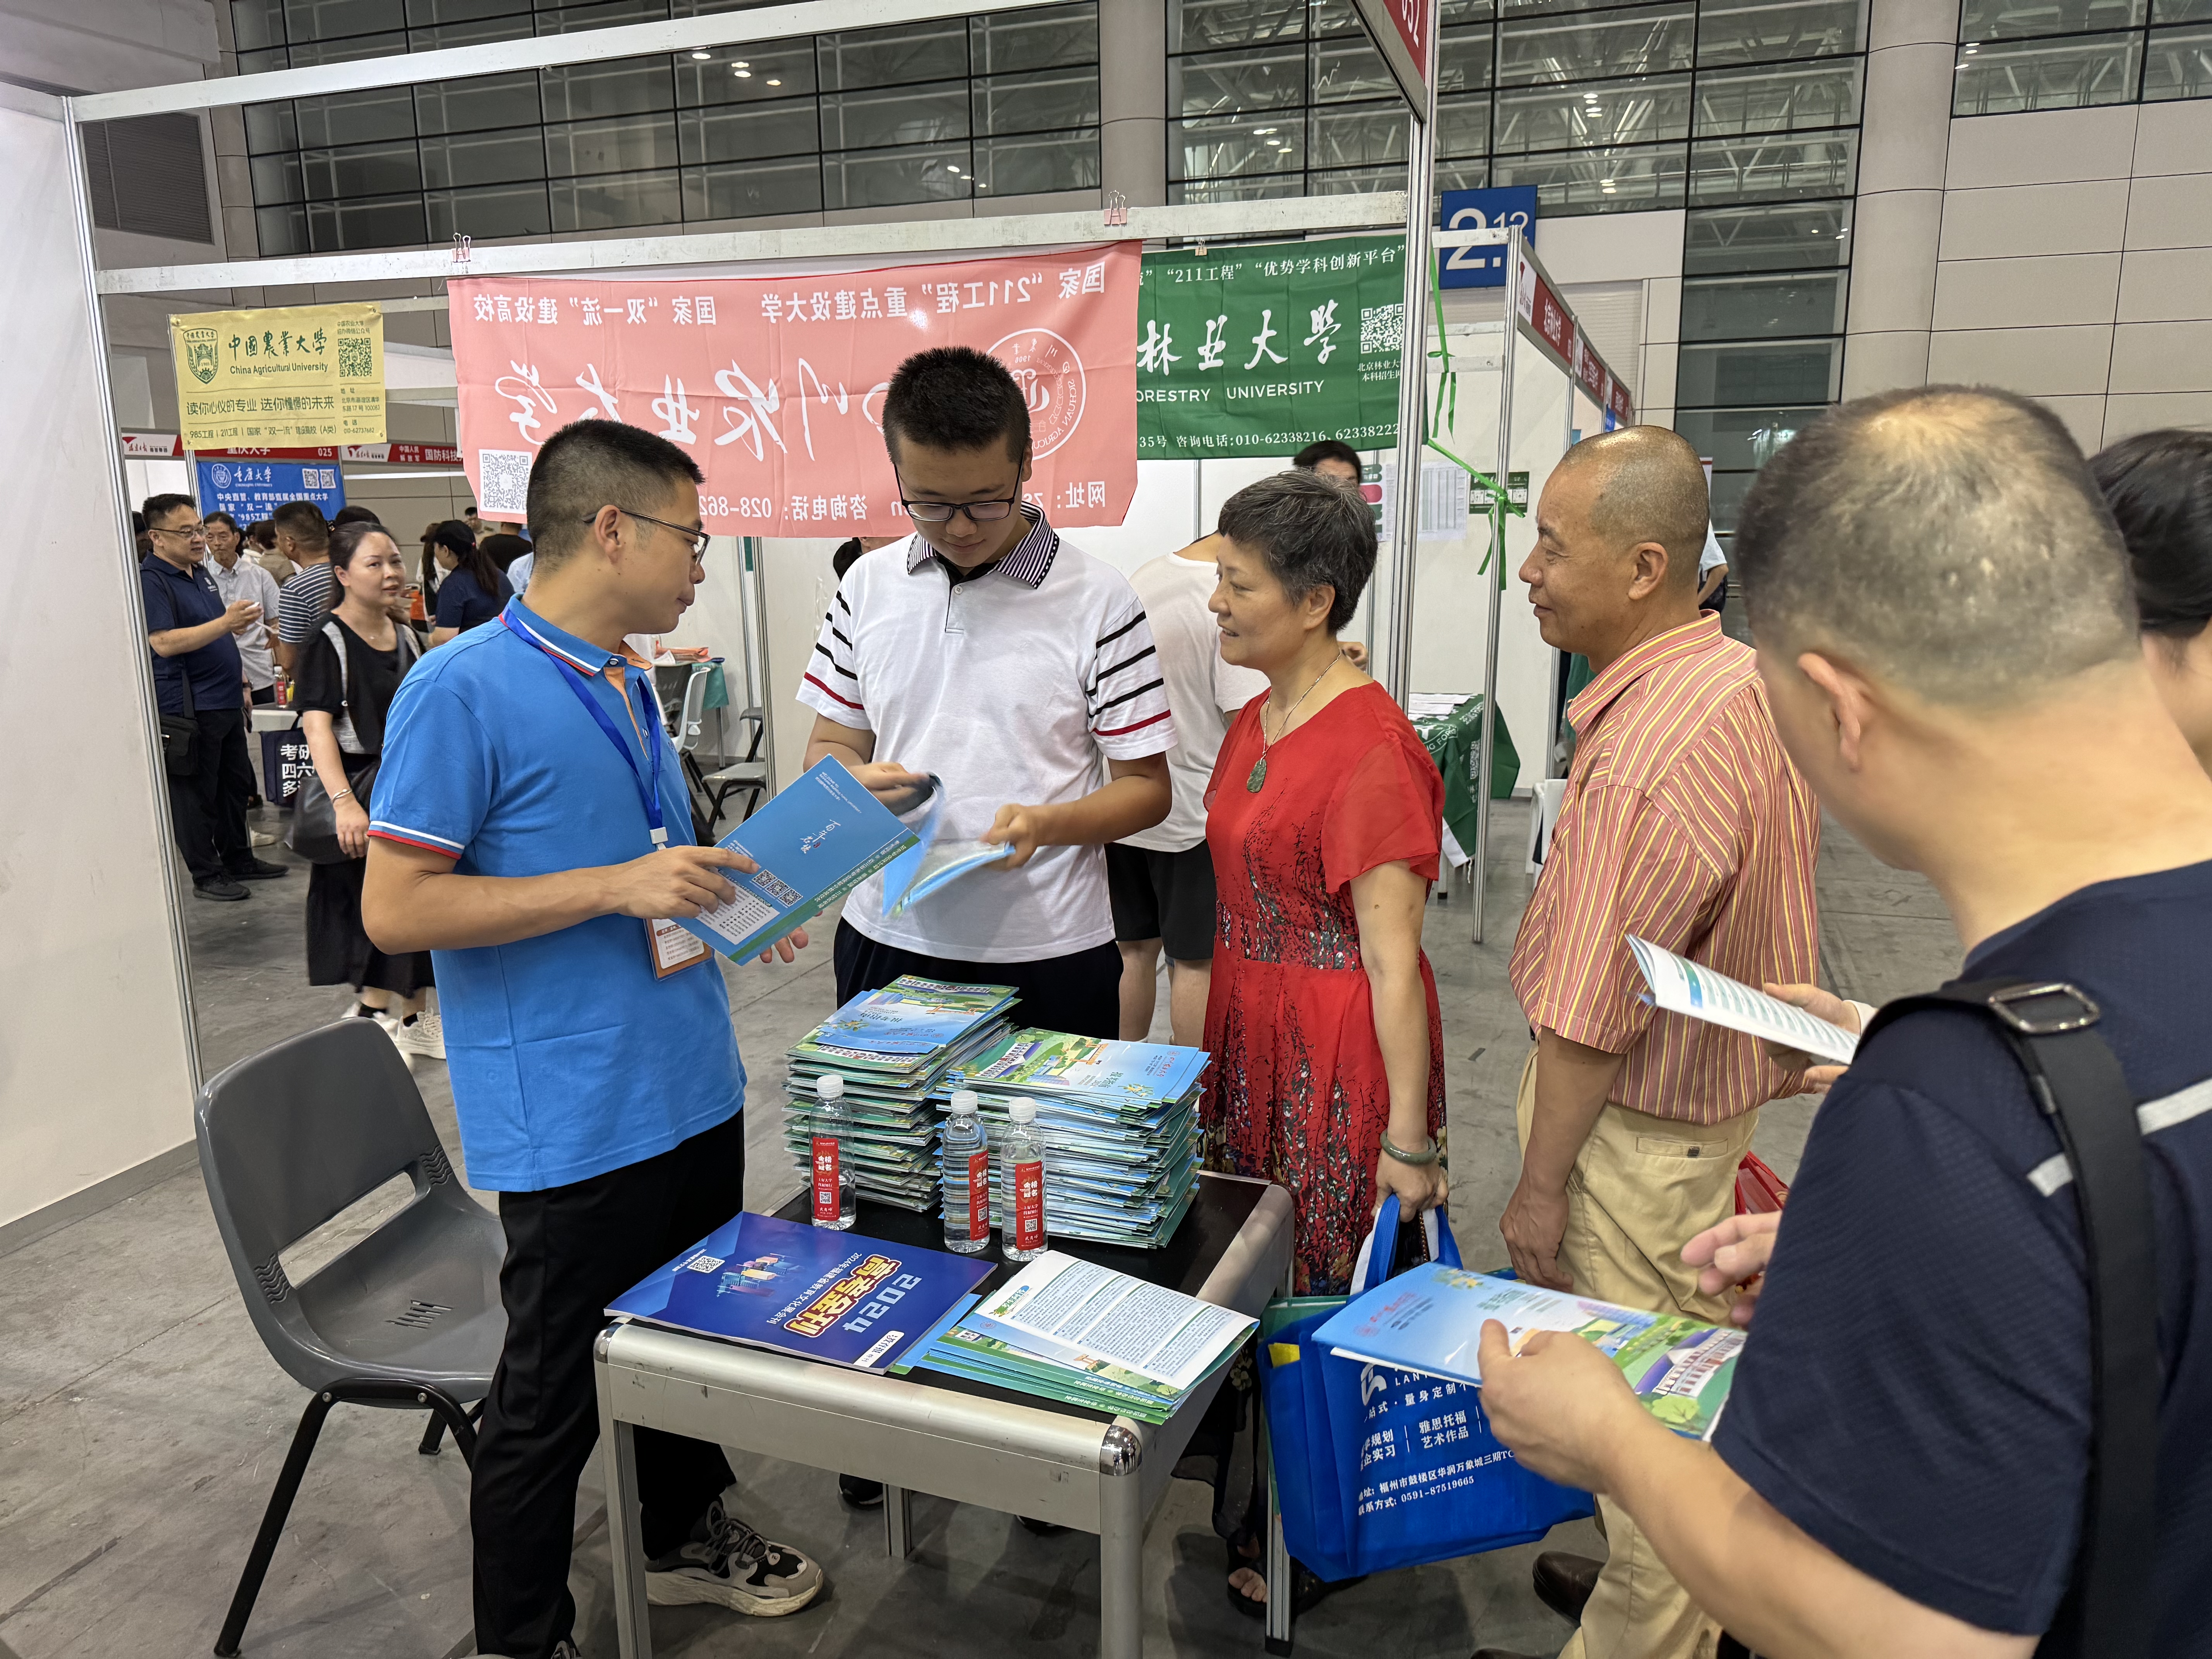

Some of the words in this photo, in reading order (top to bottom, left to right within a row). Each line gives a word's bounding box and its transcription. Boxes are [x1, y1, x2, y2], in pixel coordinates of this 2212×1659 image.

[1255, 244, 1405, 277] “优势学科创新平台”
[230, 366, 252, 375] China
[253, 363, 290, 375] Agricultural
[292, 362, 328, 372] University
[1357, 359, 1401, 372] 北京林业大
[1227, 380, 1324, 400] UNIVERSITY
[186, 398, 257, 416] 读你心仪的专业
[260, 395, 335, 411] 选你憧憬的未来
[318, 448, 332, 457] 025
[424, 448, 463, 462] 国防科技
[788, 1256, 898, 1336] 高考金刊
[842, 1274, 922, 1333] 2024
[1419, 1410, 1467, 1434] 雅思托福
[1421, 1425, 1469, 1449] 艺术作品
